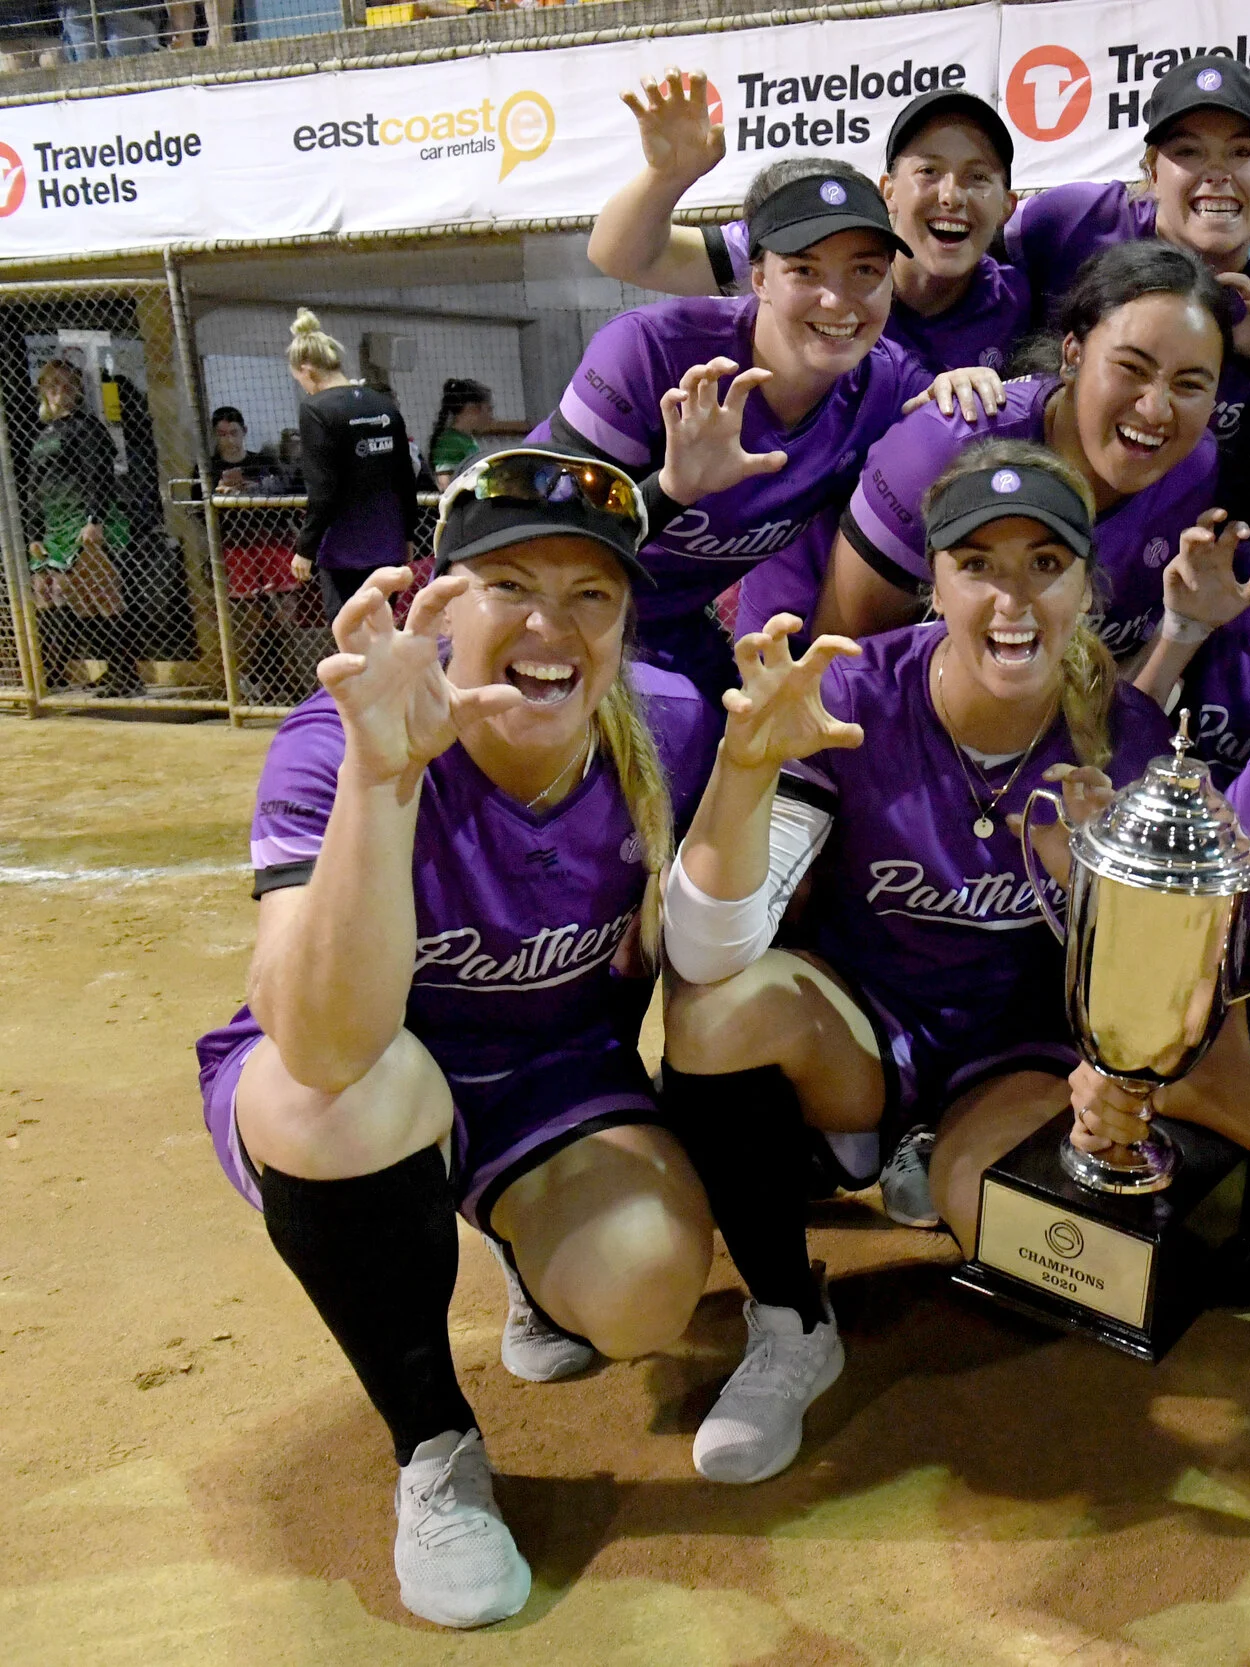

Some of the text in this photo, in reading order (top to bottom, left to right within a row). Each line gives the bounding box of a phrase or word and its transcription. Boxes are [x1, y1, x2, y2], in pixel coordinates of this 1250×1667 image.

[737, 60, 967, 109] Travelodge
[293, 98, 496, 152] eastcoast
[737, 109, 871, 152] Hotels
[34, 129, 202, 173] Travelodge
[420, 138, 496, 162] car rentals
[38, 173, 138, 209] Hotels
[1018, 1247, 1105, 1291] CHAMPIONS
[1042, 1271, 1078, 1294] 2020
